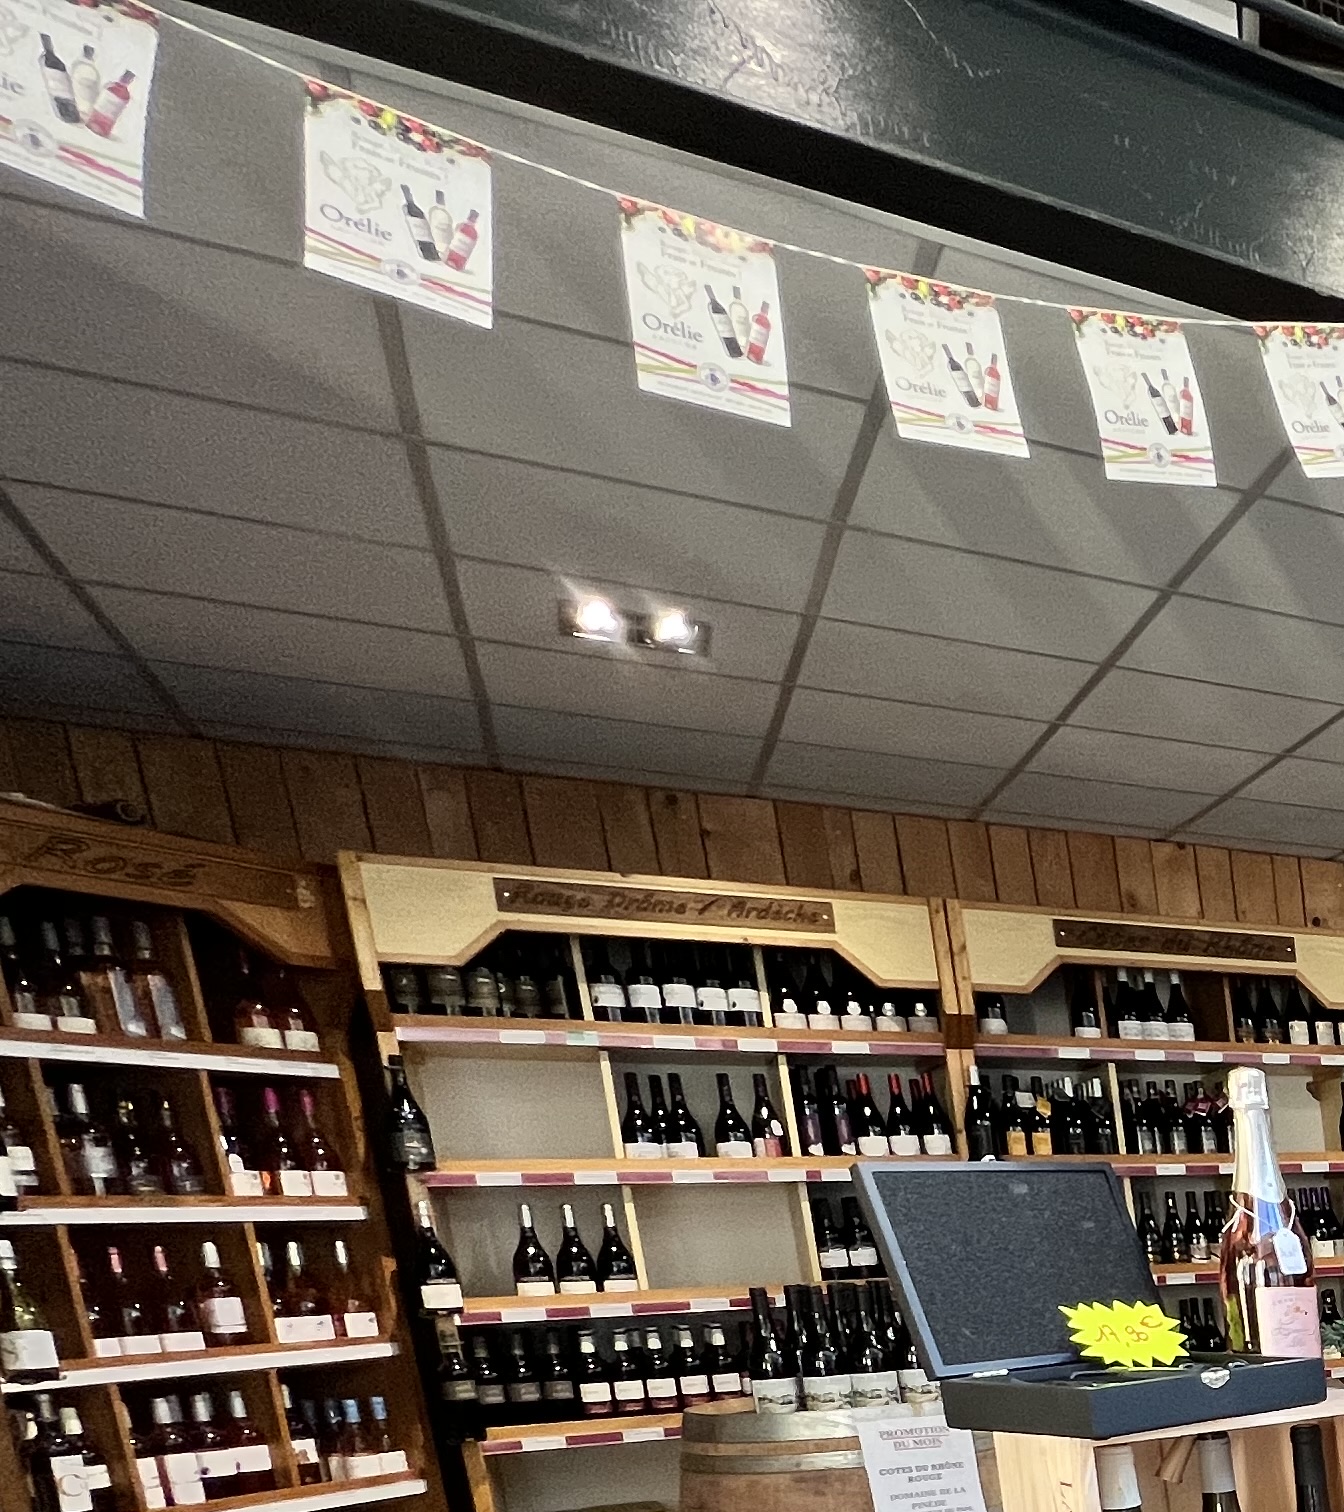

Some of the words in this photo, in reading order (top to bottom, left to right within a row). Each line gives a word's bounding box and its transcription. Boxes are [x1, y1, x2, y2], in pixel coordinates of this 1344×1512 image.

[319, 203, 393, 242] Orélie
[641, 312, 704, 344] Orélie
[895, 376, 947, 399] Orélie
[1104, 409, 1149, 428] Orélie
[1291, 420, 1330, 434] Orélie
[879, 1425, 950, 1438] PROMOTION
[893, 1440, 910, 1450] DU
[913, 1437, 944, 1449] MOIS
[879, 1465, 913, 1476] COTES
[916, 1464, 929, 1473] DU
[908, 1473, 943, 1483] ROUGE
[890, 1490, 937, 1501] DOMAINE
[939, 1488, 952, 1496] DE
[954, 1486, 967, 1494] LA
